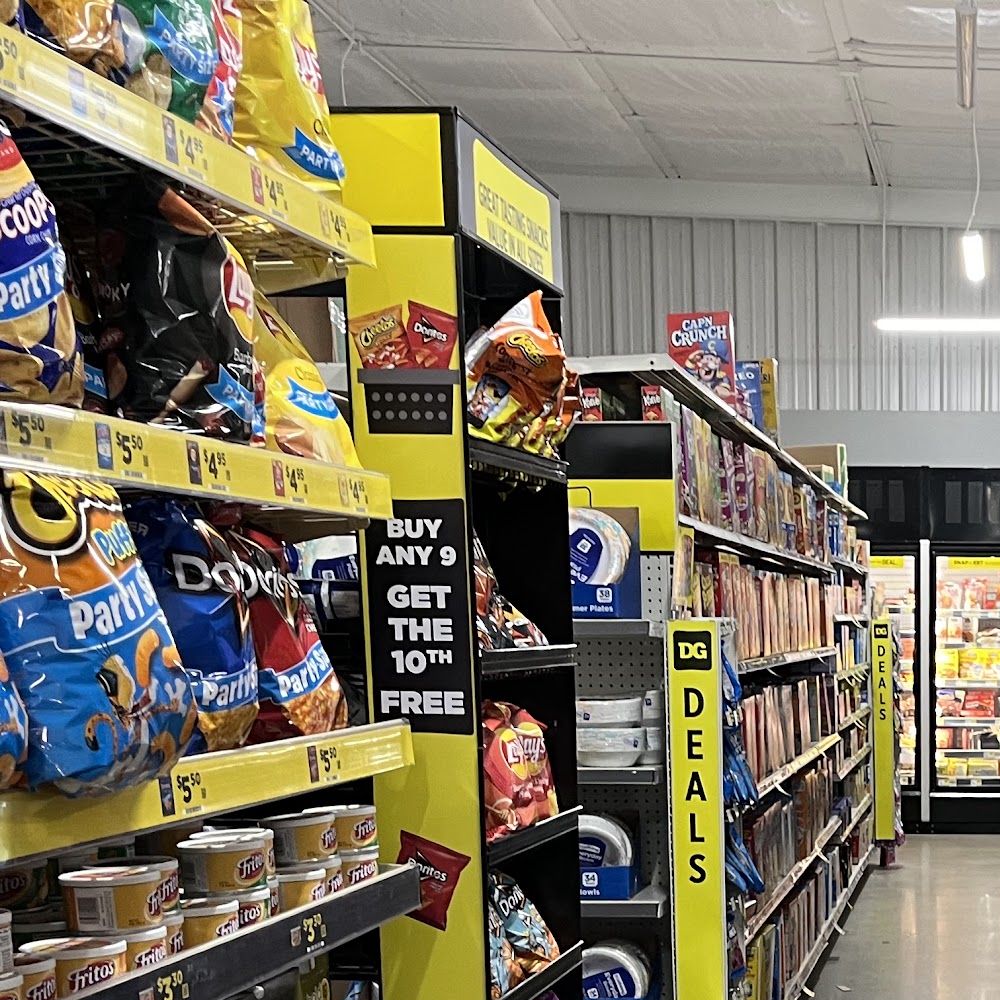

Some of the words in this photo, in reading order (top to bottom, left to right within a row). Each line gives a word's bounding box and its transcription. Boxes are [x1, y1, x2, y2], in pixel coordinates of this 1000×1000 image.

[0, 189, 56, 240] COOPS
[360, 316, 396, 348] Cheetos
[413, 322, 448, 344] Doritos
[671, 324, 728, 348] CRUNCH
[387, 518, 443, 539] BUY
[376, 545, 434, 566] ANY
[440, 546, 457, 566] 9
[387, 584, 452, 609] GET
[598, 589, 611, 598] 38
[589, 604, 614, 613] Plates
[388, 617, 454, 642] THE
[391, 649, 453, 674] 10TH
[678, 641, 708, 660] DG
[878, 645, 887, 721] DEALS
[380, 690, 466, 715] FREE
[683, 687, 707, 884] DEALS
[70, 960, 115, 994] Fritos
